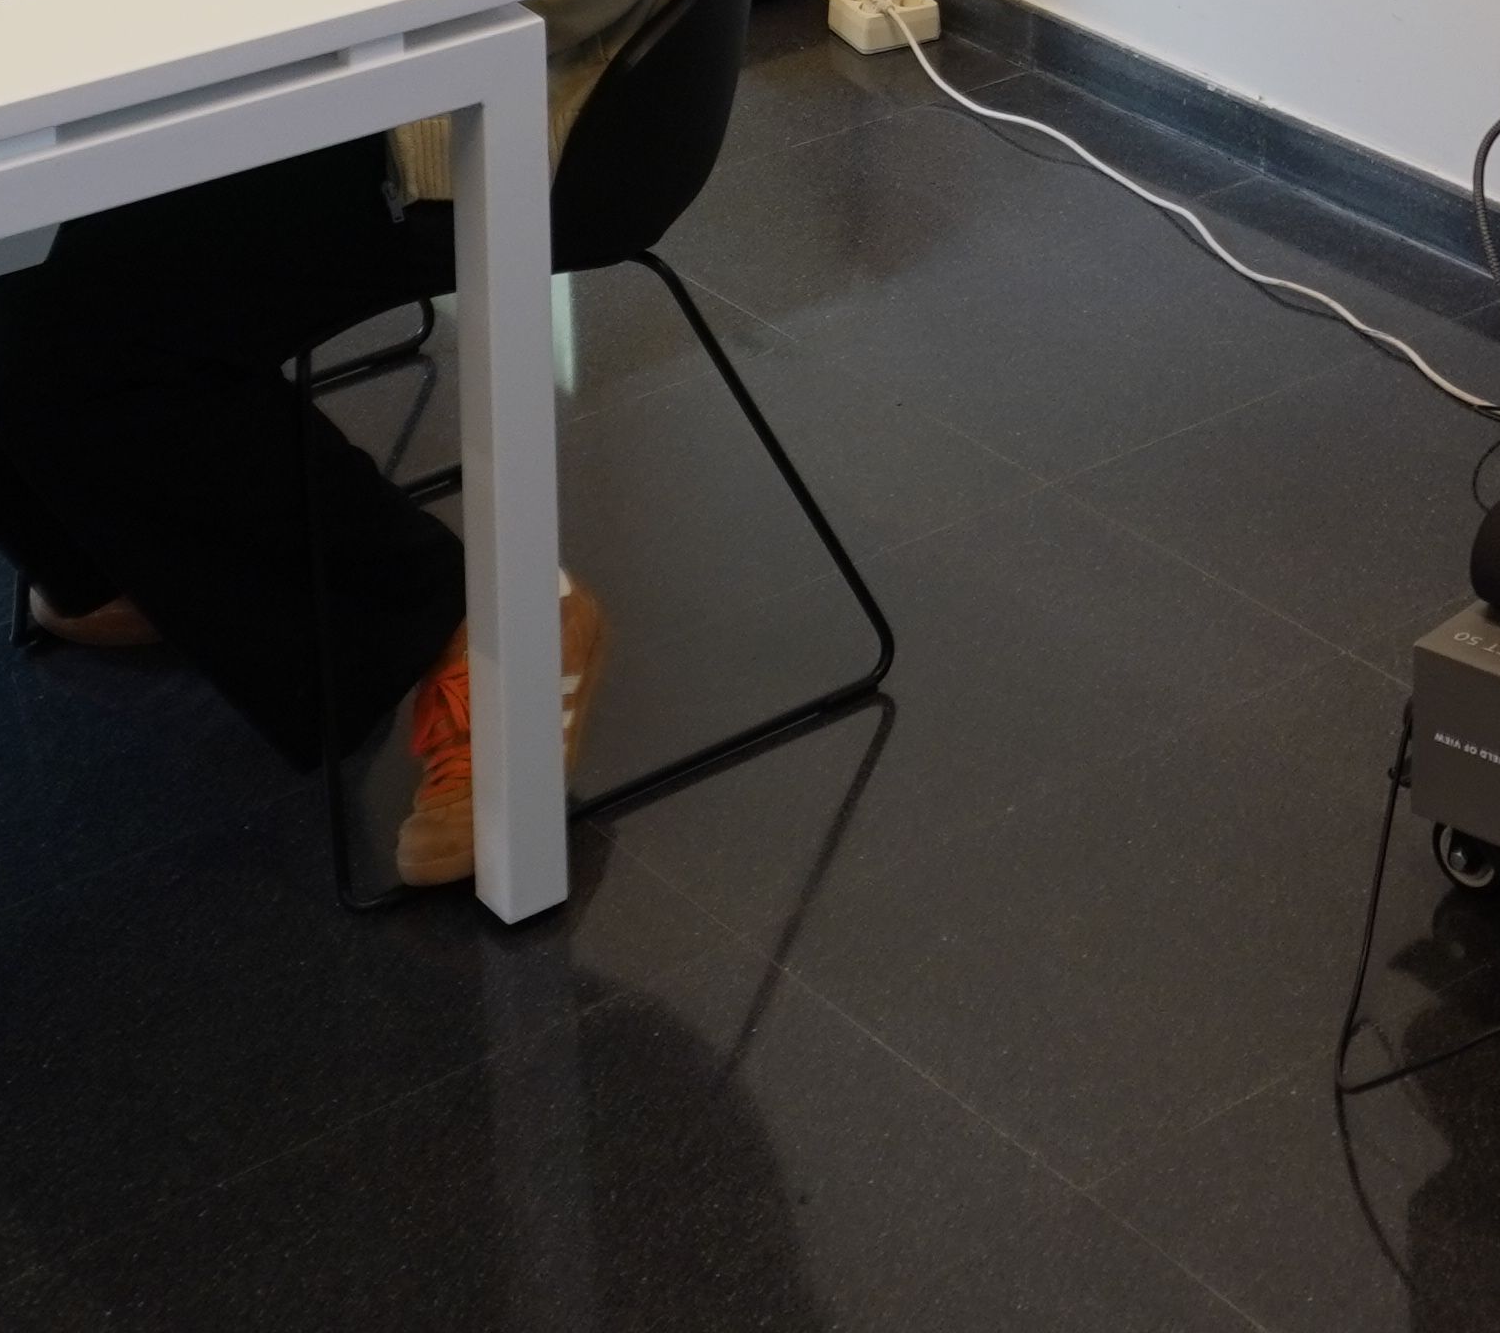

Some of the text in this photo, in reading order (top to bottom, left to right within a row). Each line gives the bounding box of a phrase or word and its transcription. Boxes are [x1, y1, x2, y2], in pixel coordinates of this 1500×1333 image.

[1453, 629, 1485, 646] 50
[1432, 732, 1463, 750] VIEW
[1462, 740, 1479, 756] OF
